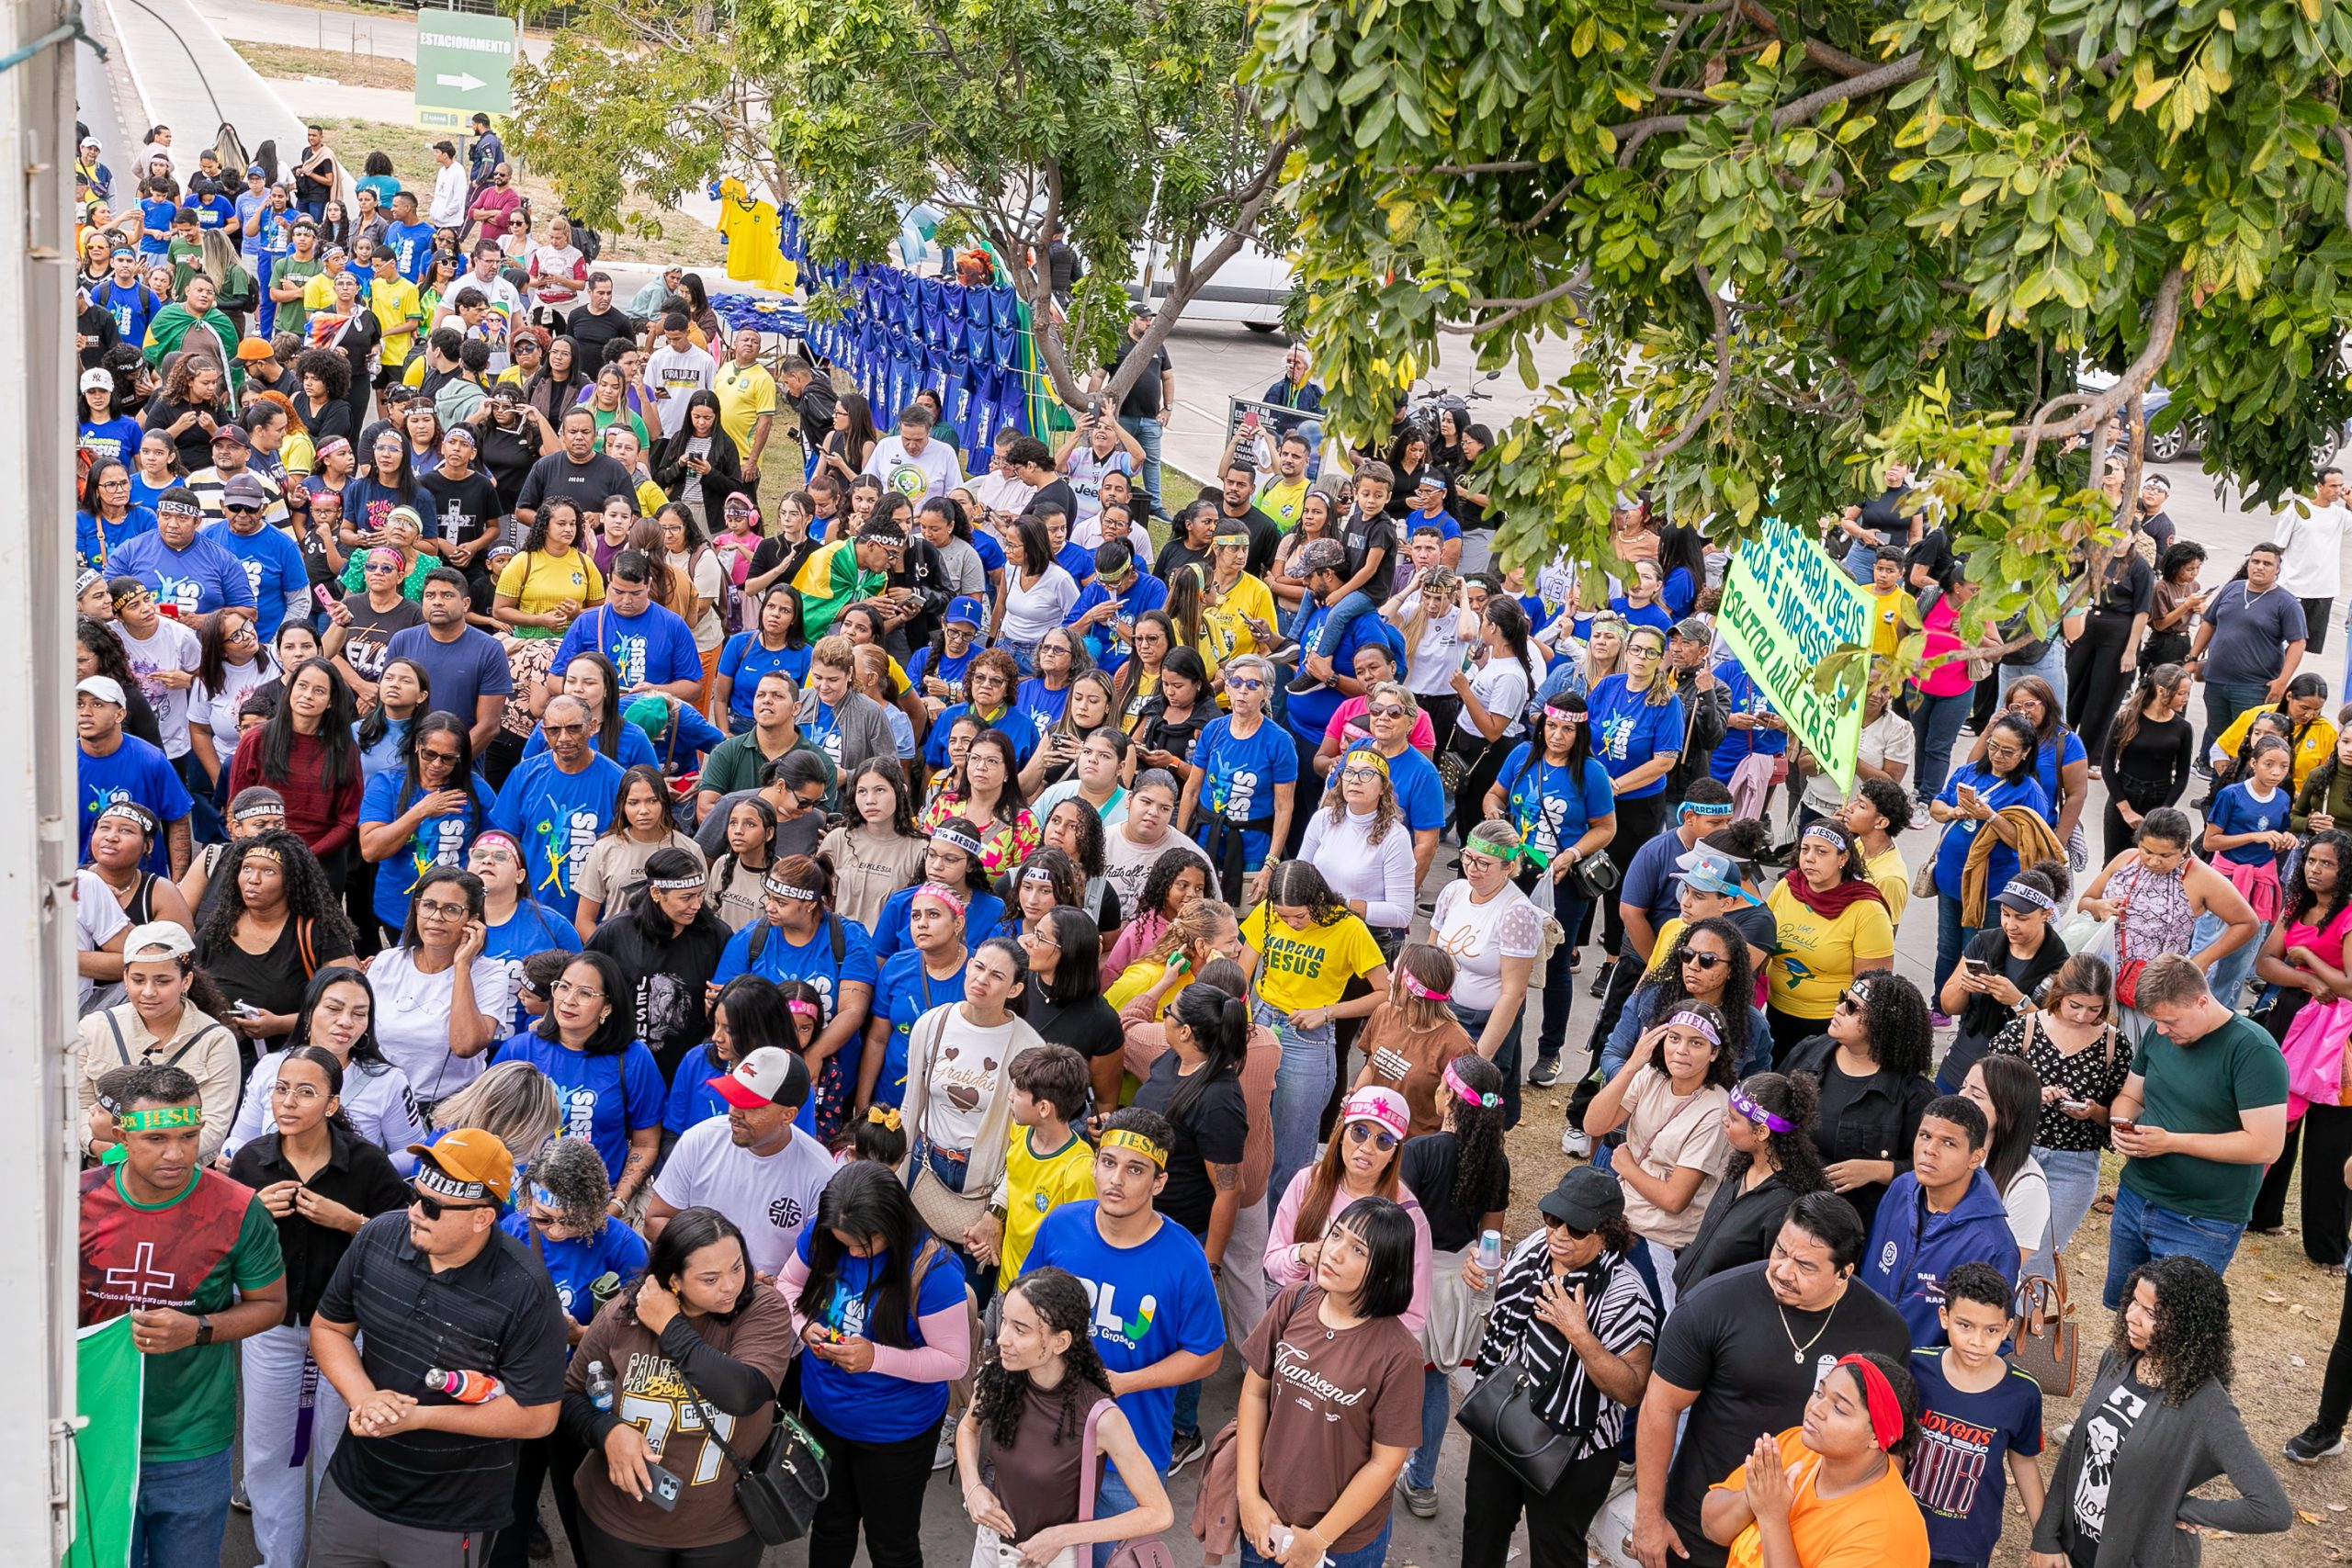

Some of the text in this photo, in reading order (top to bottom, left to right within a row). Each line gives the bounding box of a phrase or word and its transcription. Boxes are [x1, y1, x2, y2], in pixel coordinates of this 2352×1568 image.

[420, 32, 512, 54] ESTACIONAMENTO
[159, 501, 200, 516] JESUS
[870, 535, 899, 546] 100%
[1795, 539, 1828, 614] PARA
[1826, 580, 1865, 645] DEUS
[630, 637, 646, 683] JESUS
[1552, 710, 1585, 723] JESUS
[1613, 719, 1634, 761] JESUS
[1353, 751, 1388, 773] JESUS
[1226, 771, 1258, 822] ESUS
[235, 806, 272, 820] MARCHA
[436, 819, 466, 867] SUS
[951, 834, 979, 852] JESUS
[1813, 828, 1841, 845] JESUS
[653, 878, 696, 889] MARCHA
[774, 883, 815, 901] JESUS
[724, 891, 755, 908] EKKLESIA
[2020, 887, 2049, 907] JESUS
[1268, 952, 1322, 979] ESUS
[637, 976, 647, 1043] JESU
[1678, 1012, 1708, 1032] FIEL
[143, 1109, 201, 1128] JESUS
[569, 1091, 594, 1141] ESUS
[1123, 1131, 1168, 1163] JESUS
[435, 1171, 466, 1197] FIEL
[1917, 1272, 1936, 1281] RAIA
[124, 1293, 141, 1302] fonte
[142, 1296, 156, 1304] para
[1274, 1341, 1366, 1406] Transcend
[1917, 1409, 1995, 1445] Jovens
[1919, 1427, 1950, 1443] OCÊS
[1906, 1436, 1986, 1515] ORTES
